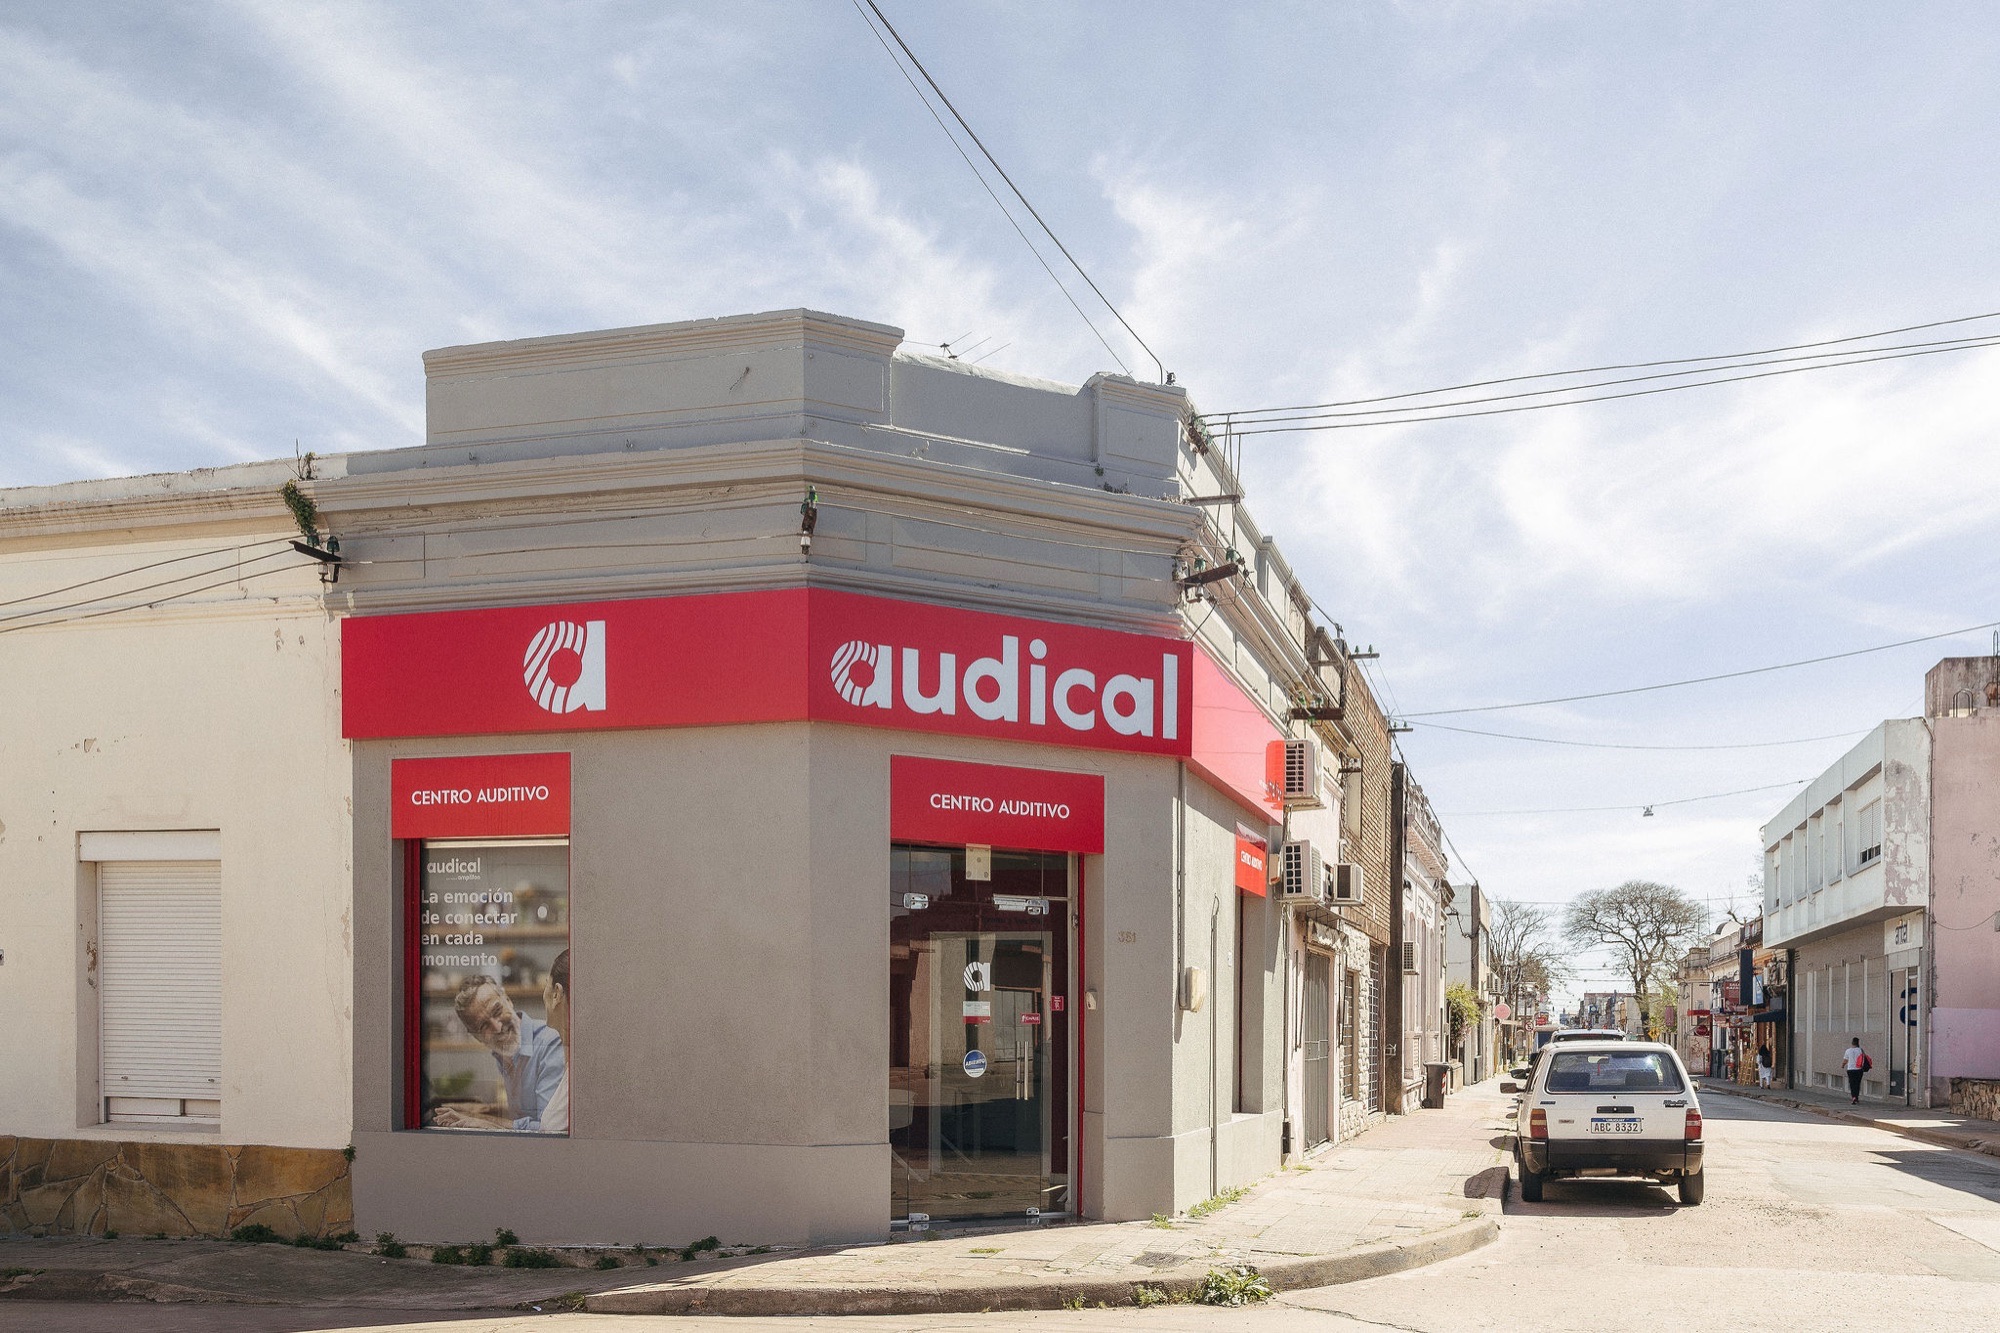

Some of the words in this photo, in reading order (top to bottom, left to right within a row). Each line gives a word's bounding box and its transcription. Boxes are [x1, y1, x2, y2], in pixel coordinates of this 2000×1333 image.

[831, 634, 1178, 740] audical
[411, 787, 473, 807] CENTRO
[476, 785, 550, 804] AUDITIVO
[929, 793, 994, 813] CENTRO
[998, 799, 1070, 819] AUDITIVO
[427, 858, 480, 873] audical
[421, 890, 438, 903] La
[444, 888, 513, 903] emoción
[421, 910, 440, 924] de
[445, 911, 518, 924] conectar
[421, 933, 440, 945] en
[445, 931, 483, 945] cada
[421, 953, 498, 966] momento
[1594, 1123, 1611, 1132] ABC
[1615, 1123, 1638, 1132] 8332
